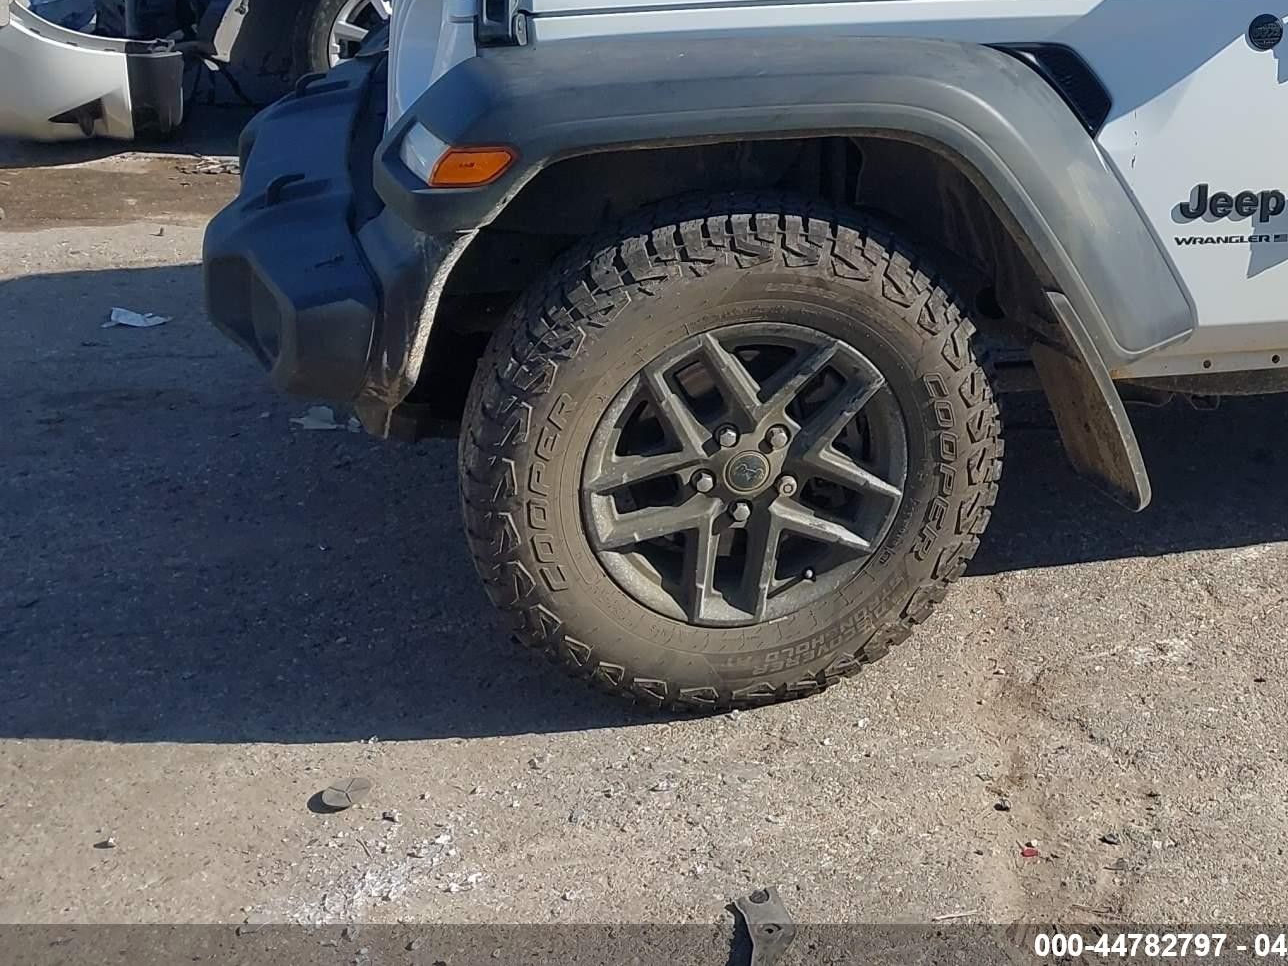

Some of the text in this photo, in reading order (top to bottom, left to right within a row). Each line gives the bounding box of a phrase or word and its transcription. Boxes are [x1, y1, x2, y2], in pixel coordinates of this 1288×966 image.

[1174, 234, 1271, 246] WRANGLER
[1180, 183, 1286, 222] Jeep
[528, 393, 575, 591] COOPER
[916, 372, 958, 561] COOPER
